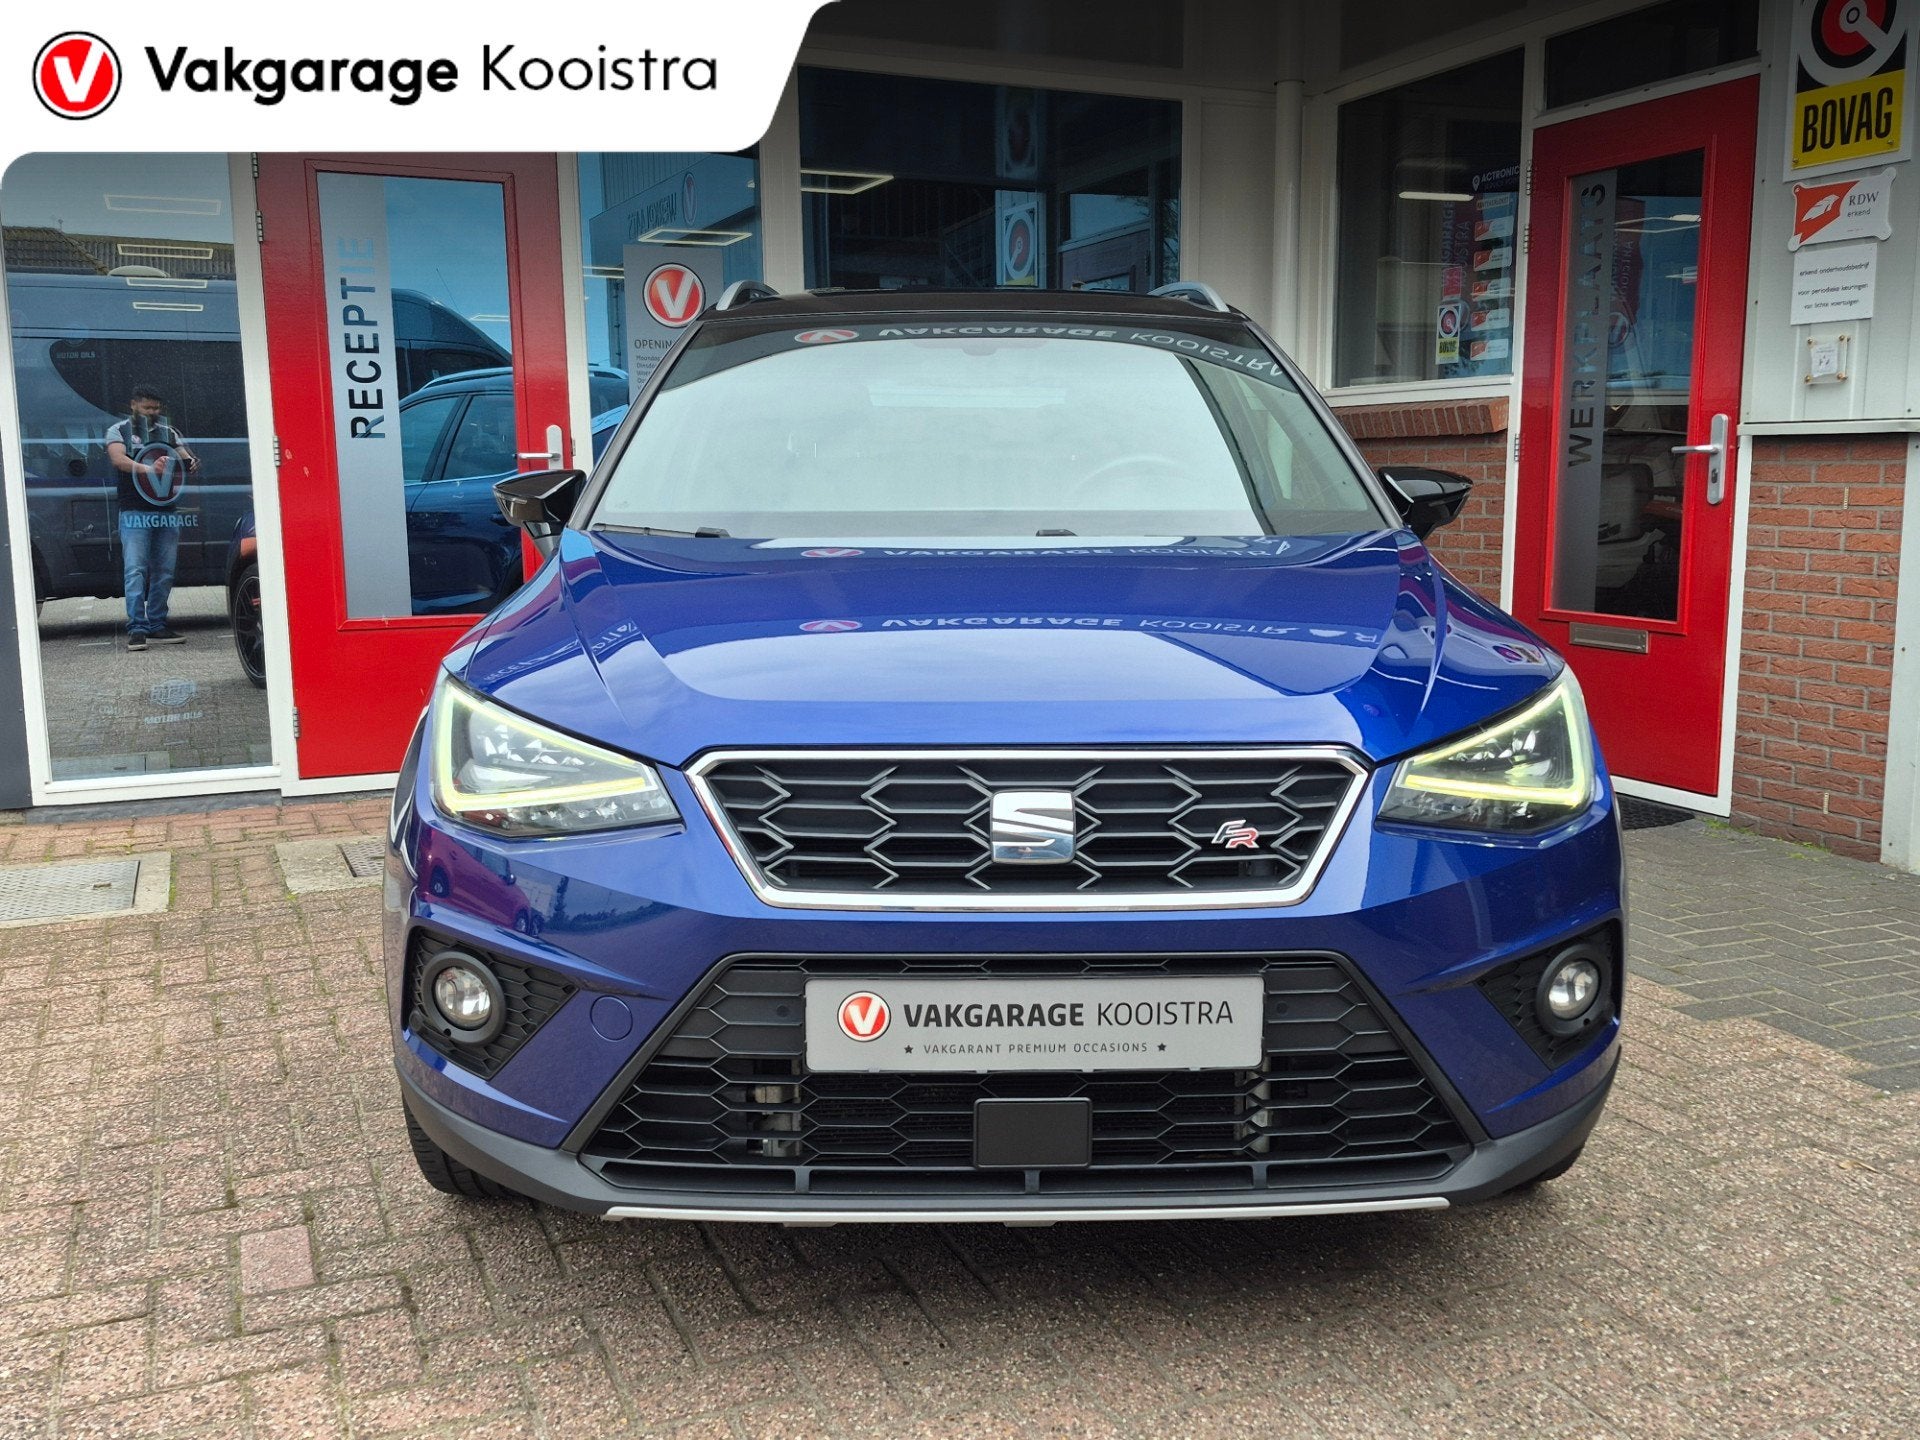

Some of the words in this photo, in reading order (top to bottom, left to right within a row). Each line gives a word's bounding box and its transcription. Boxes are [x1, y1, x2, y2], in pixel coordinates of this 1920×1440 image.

[1802, 87, 1894, 153] BOVAG
[1849, 191, 1879, 206] RDW
[1847, 208, 1871, 217] erkend
[338, 237, 386, 438] RECEPTIE
[1568, 183, 1606, 468] WERKPLAATS
[123, 514, 199, 529] VAKGARAGE
[1211, 819, 1260, 848] FR
[903, 1003, 1084, 1028] VAKGARAGE
[1097, 1001, 1233, 1026] KOOISTRA
[923, 1043, 1001, 1054] VAKGARANT
[1008, 1043, 1067, 1054] PREMIUM
[1073, 1041, 1148, 1053] OCCASIONS
